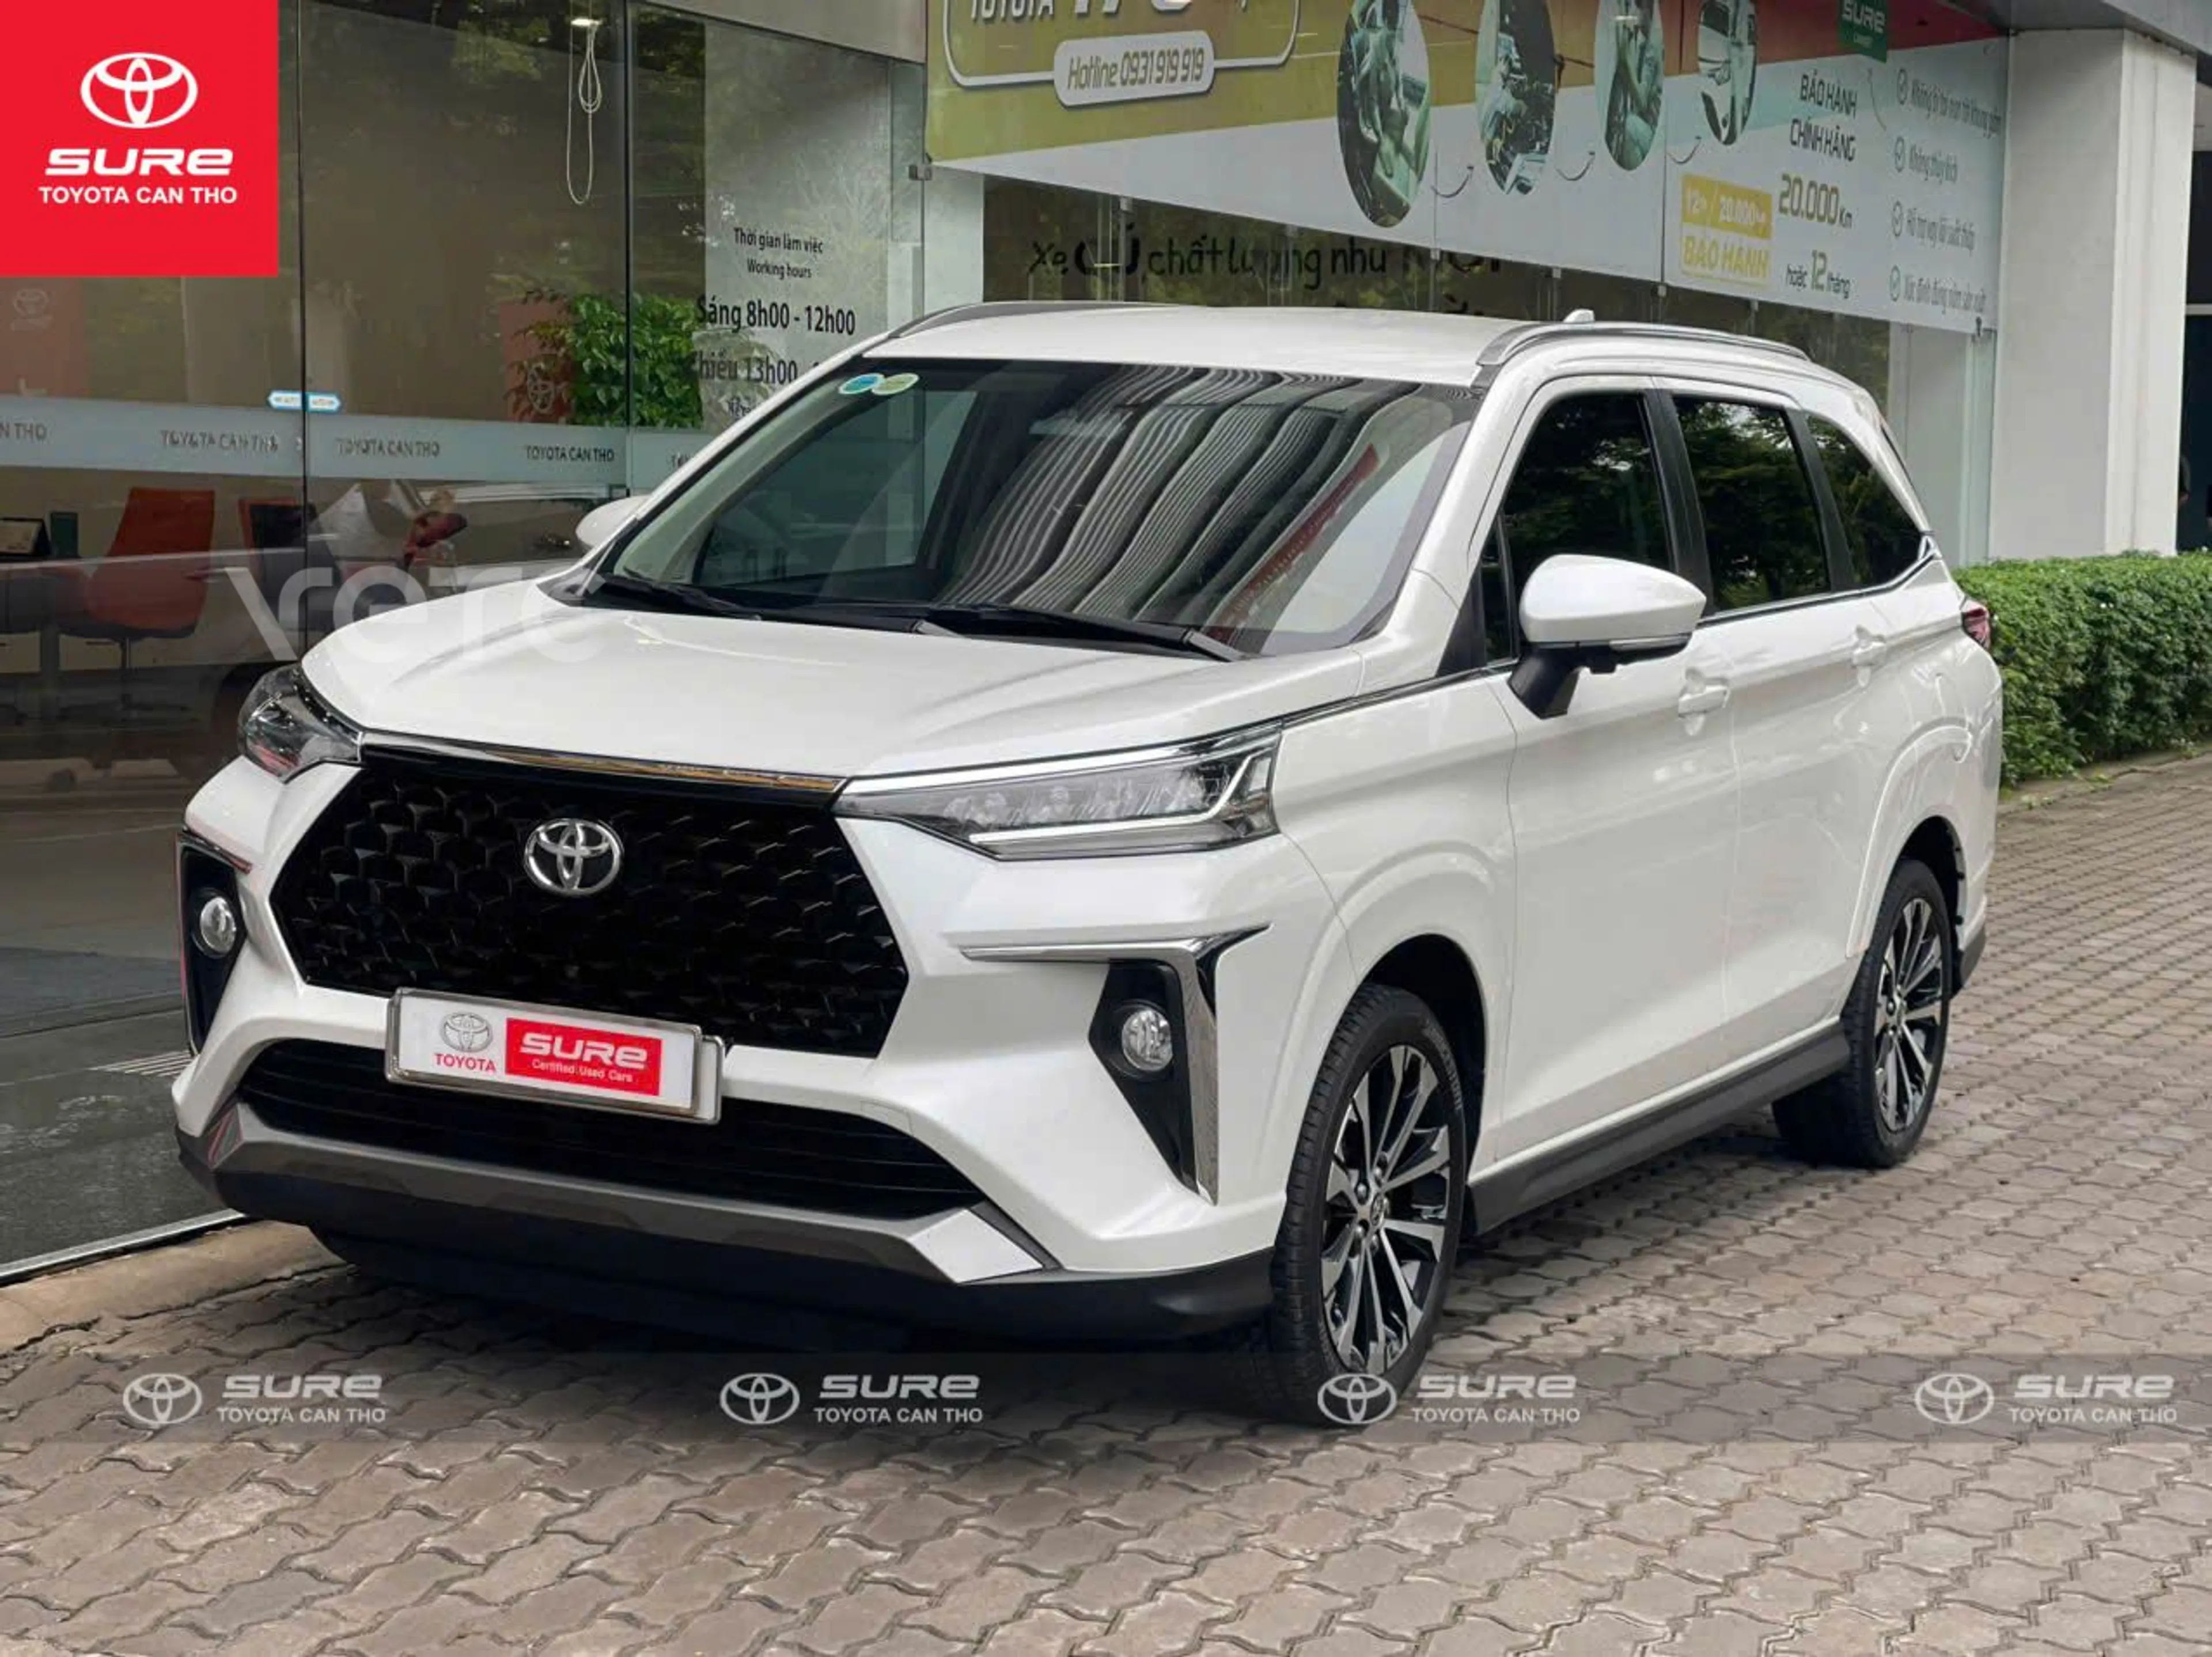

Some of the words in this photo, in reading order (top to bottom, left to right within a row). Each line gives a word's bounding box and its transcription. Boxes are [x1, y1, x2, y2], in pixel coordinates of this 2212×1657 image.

[1067, 55, 1118, 89] Hotline
[1120, 49, 1154, 86] 0931
[1155, 48, 1179, 84] 919
[1181, 47, 1205, 82] 919
[1779, 173, 1840, 225] 20.000
[759, 230, 781, 251] gian
[747, 257, 785, 280] Working
[787, 263, 812, 278] hours
[1812, 249, 1827, 291] 12
[696, 295, 741, 333] Sáng
[747, 299, 789, 329] 8h00
[805, 305, 856, 335] 12h00
[14, 422, 48, 442] THO
[527, 445, 566, 461] TOYOTA
[569, 446, 591, 462] CAN
[593, 446, 615, 462] THO
[434, 1052, 497, 1073] TOYOTA
[532, 1057, 576, 1075] Certified
[579, 1064, 605, 1079] Used
